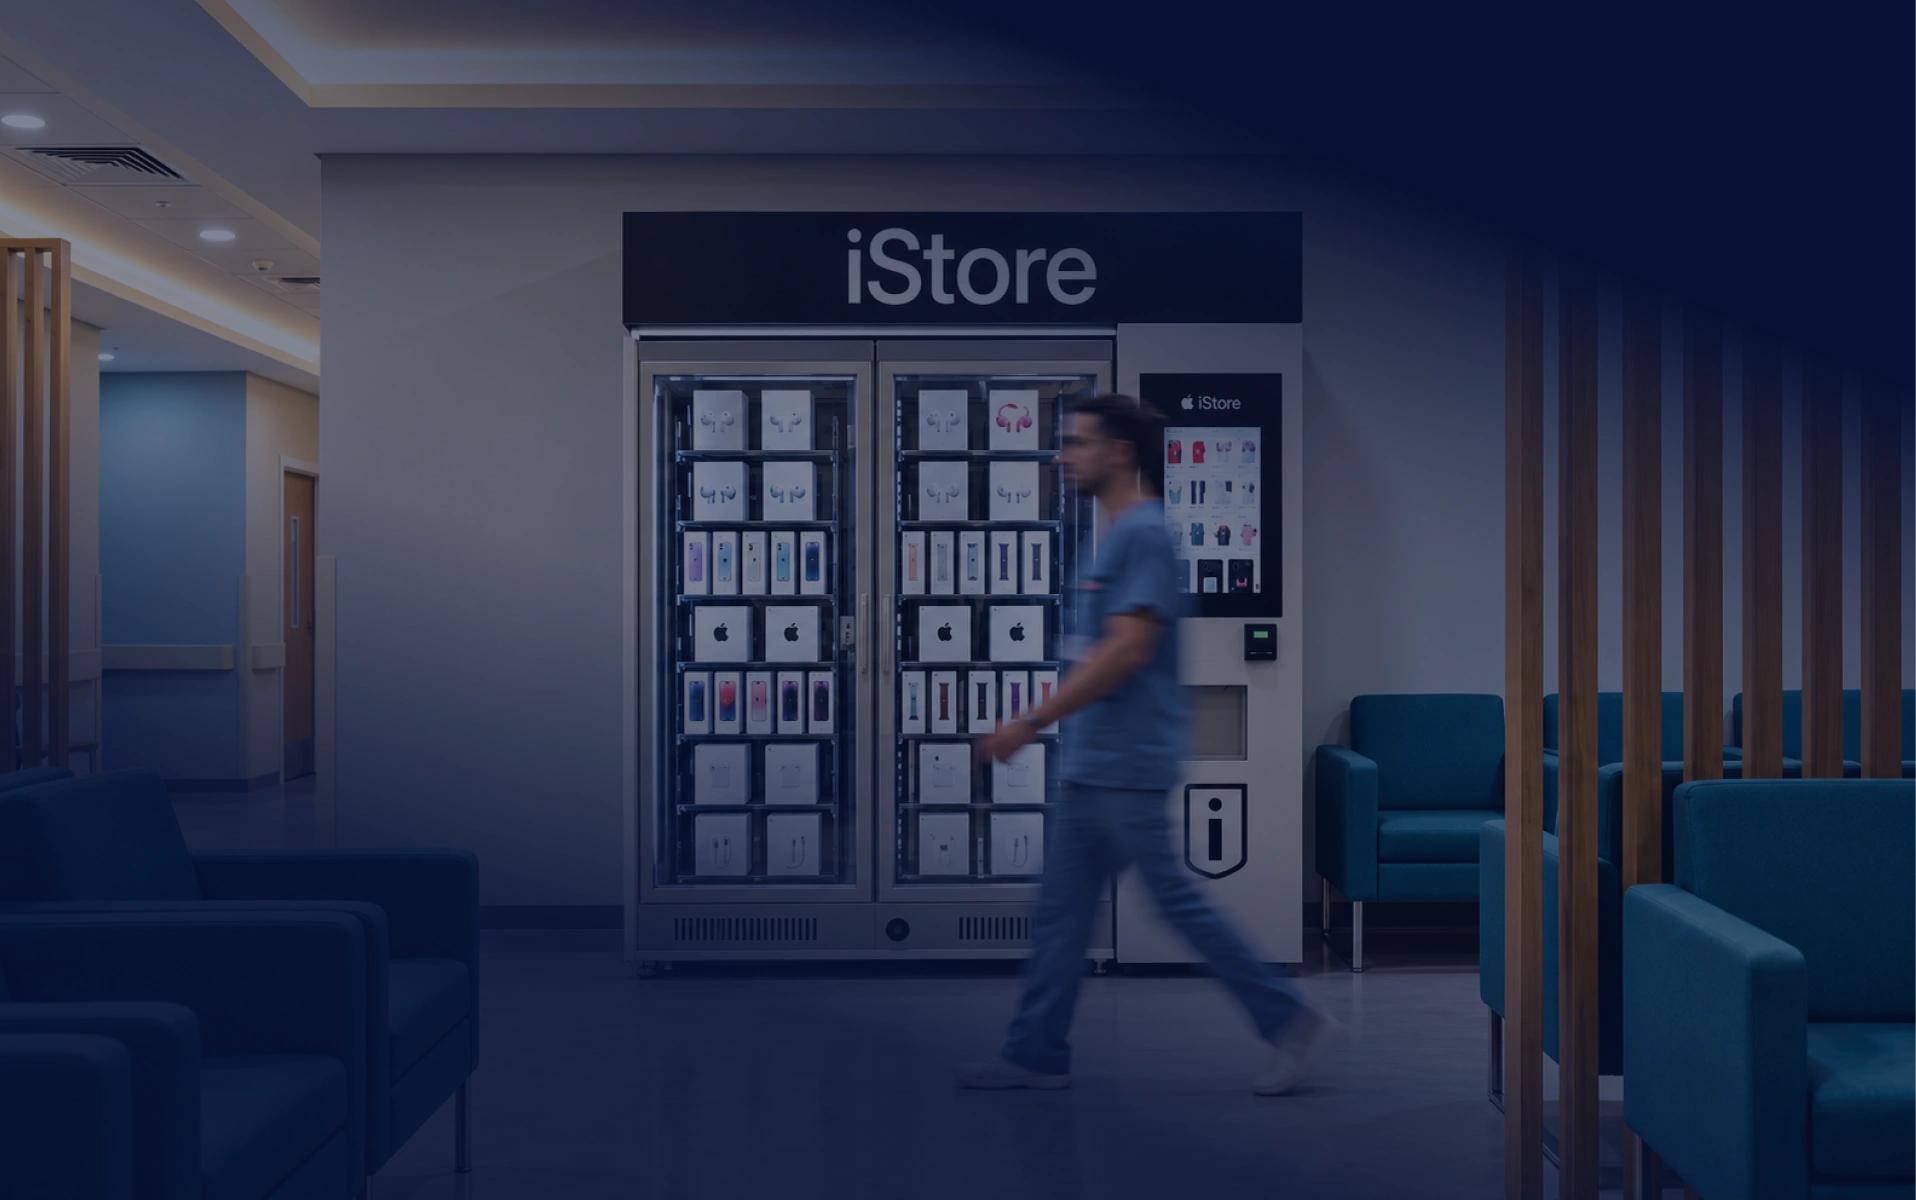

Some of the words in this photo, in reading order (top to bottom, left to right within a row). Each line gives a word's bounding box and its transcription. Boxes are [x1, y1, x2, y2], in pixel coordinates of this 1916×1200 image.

[847, 227, 1097, 305] iStore
[1198, 396, 1241, 410] iStore
[1208, 797, 1222, 861] i
